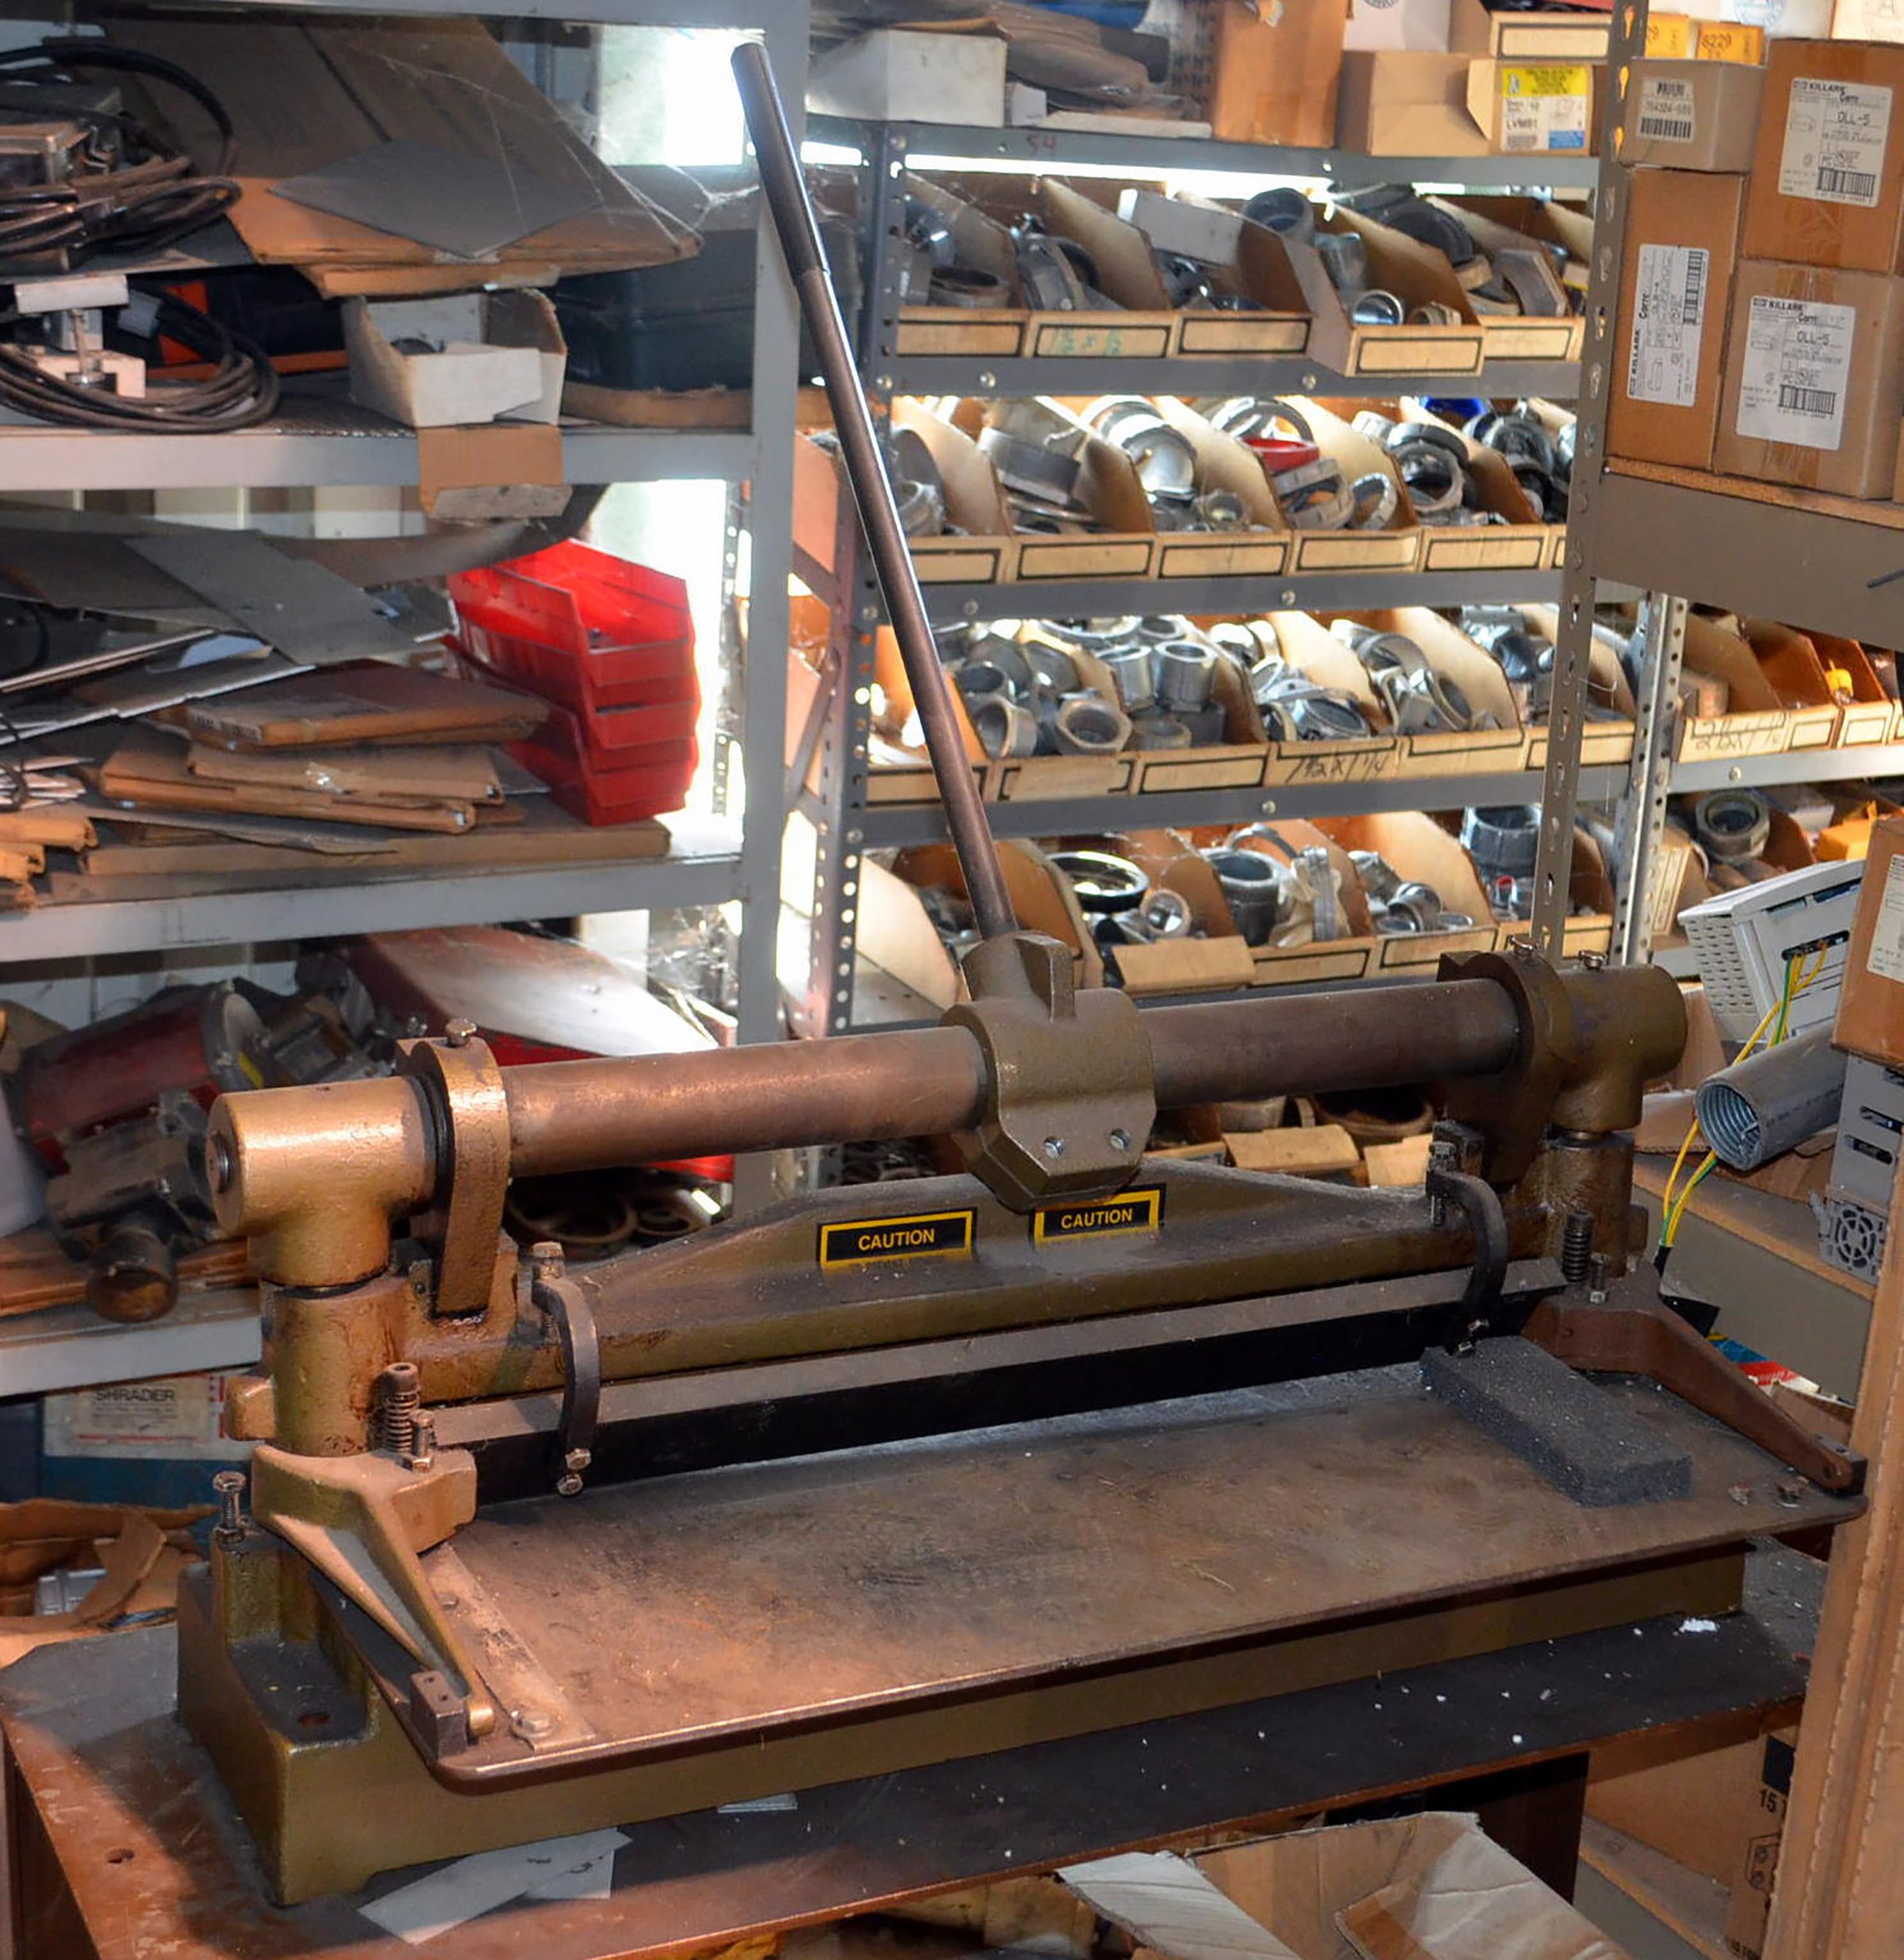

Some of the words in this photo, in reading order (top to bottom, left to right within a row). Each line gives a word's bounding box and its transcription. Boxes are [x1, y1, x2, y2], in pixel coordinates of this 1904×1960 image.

[1809, 82, 1846, 94] KILLARK
[1837, 111, 1871, 126] OLL-5
[1768, 299, 1803, 311] KILLARK
[1796, 330, 1831, 347] OLL-5
[1061, 1208, 1133, 1229] CAUTION
[858, 1229, 935, 1251] CAUTION
[1760, 1788, 1779, 1813] 15
